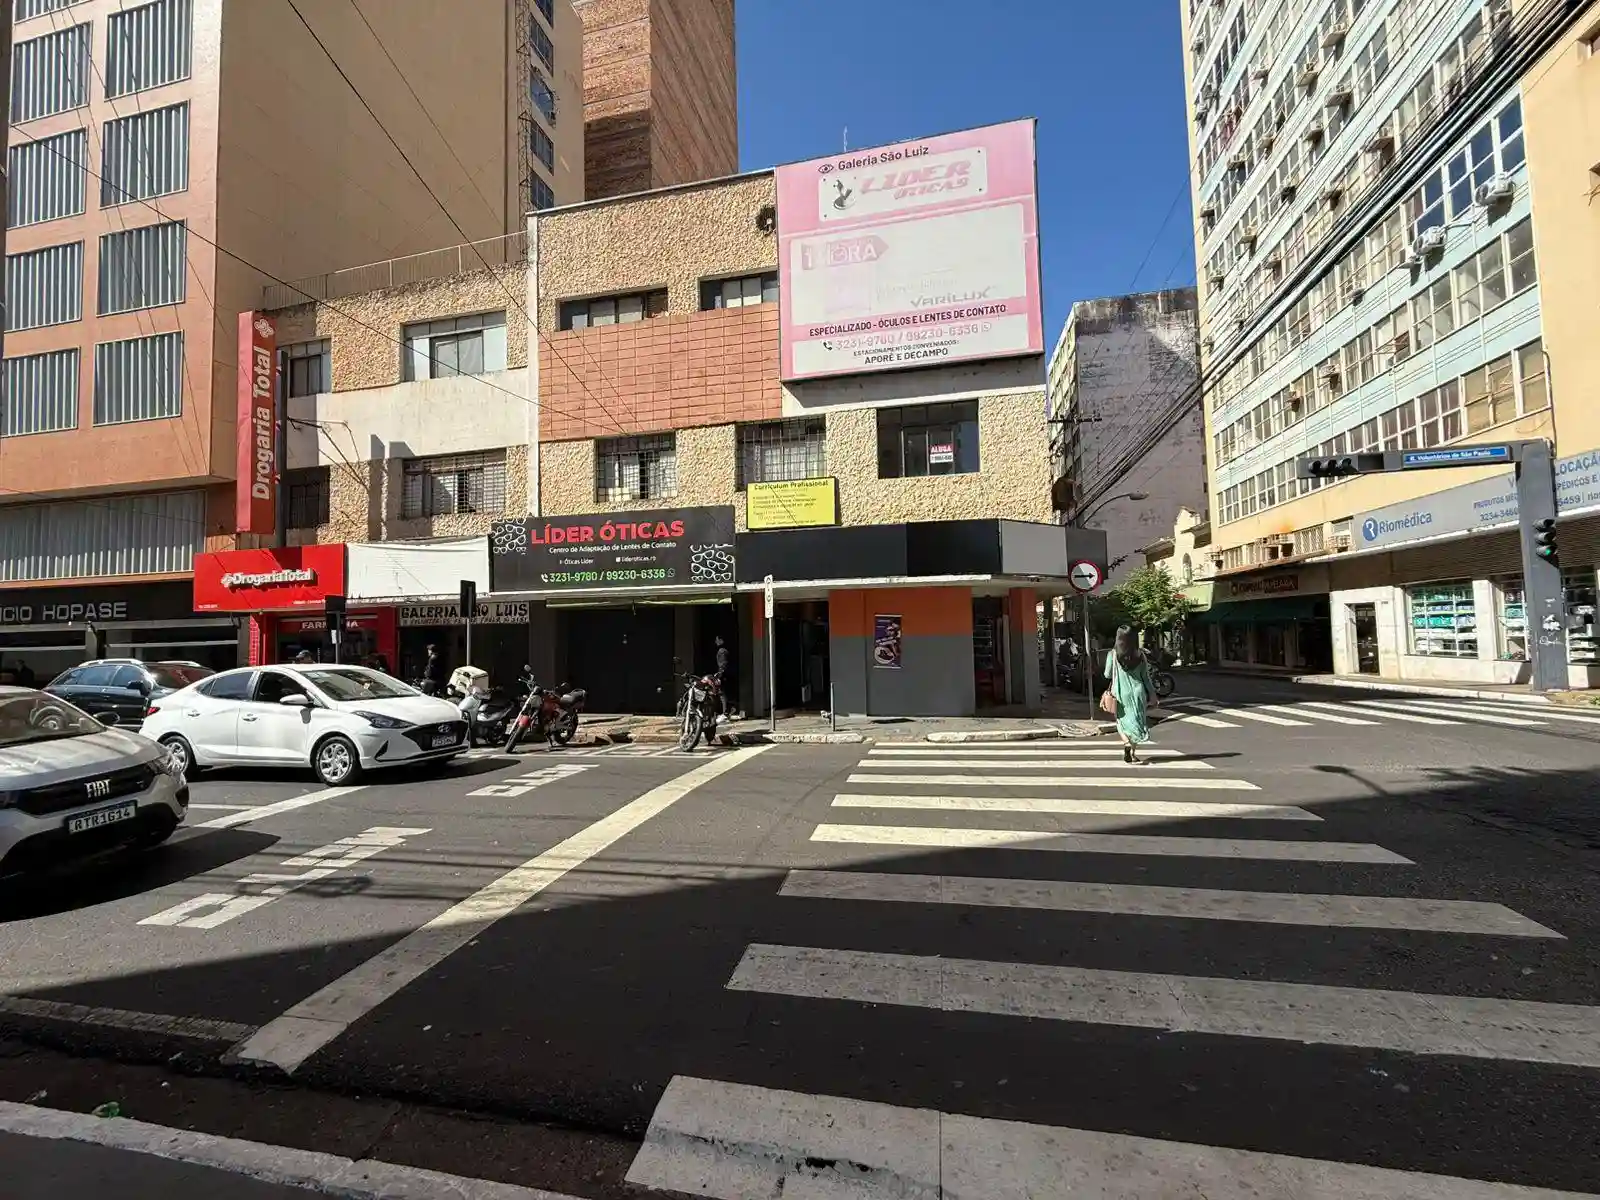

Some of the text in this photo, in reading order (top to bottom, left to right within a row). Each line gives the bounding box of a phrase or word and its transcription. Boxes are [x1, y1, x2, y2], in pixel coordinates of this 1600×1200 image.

[838, 146, 929, 171] Galeria São Luiz
[809, 321, 872, 337] ESPECIALIZADO
[878, 315, 911, 328] ÓCULOS
[912, 315, 918, 324] E
[919, 311, 952, 323] LENTES
[953, 308, 965, 319] DE
[966, 304, 1006, 317] CONTATO
[896, 352, 902, 361] E
[904, 347, 949, 361] DECAMPO
[252, 345, 274, 501] Drogaria Total
[531, 519, 685, 545] LÍDER ÓTICAS
[1379, 511, 1433, 533] Riomédica
[579, 544, 611, 554] Adaptação
[650, 541, 677, 549] Contato
[606, 568, 666, 580] 99230-6336
[42, 602, 127, 621] HOPASE
[401, 606, 458, 619] GALERIA
[496, 602, 528, 617] LUIS
[83, 779, 111, 798] FIAT
[74, 808, 131, 831] RTR1G14
